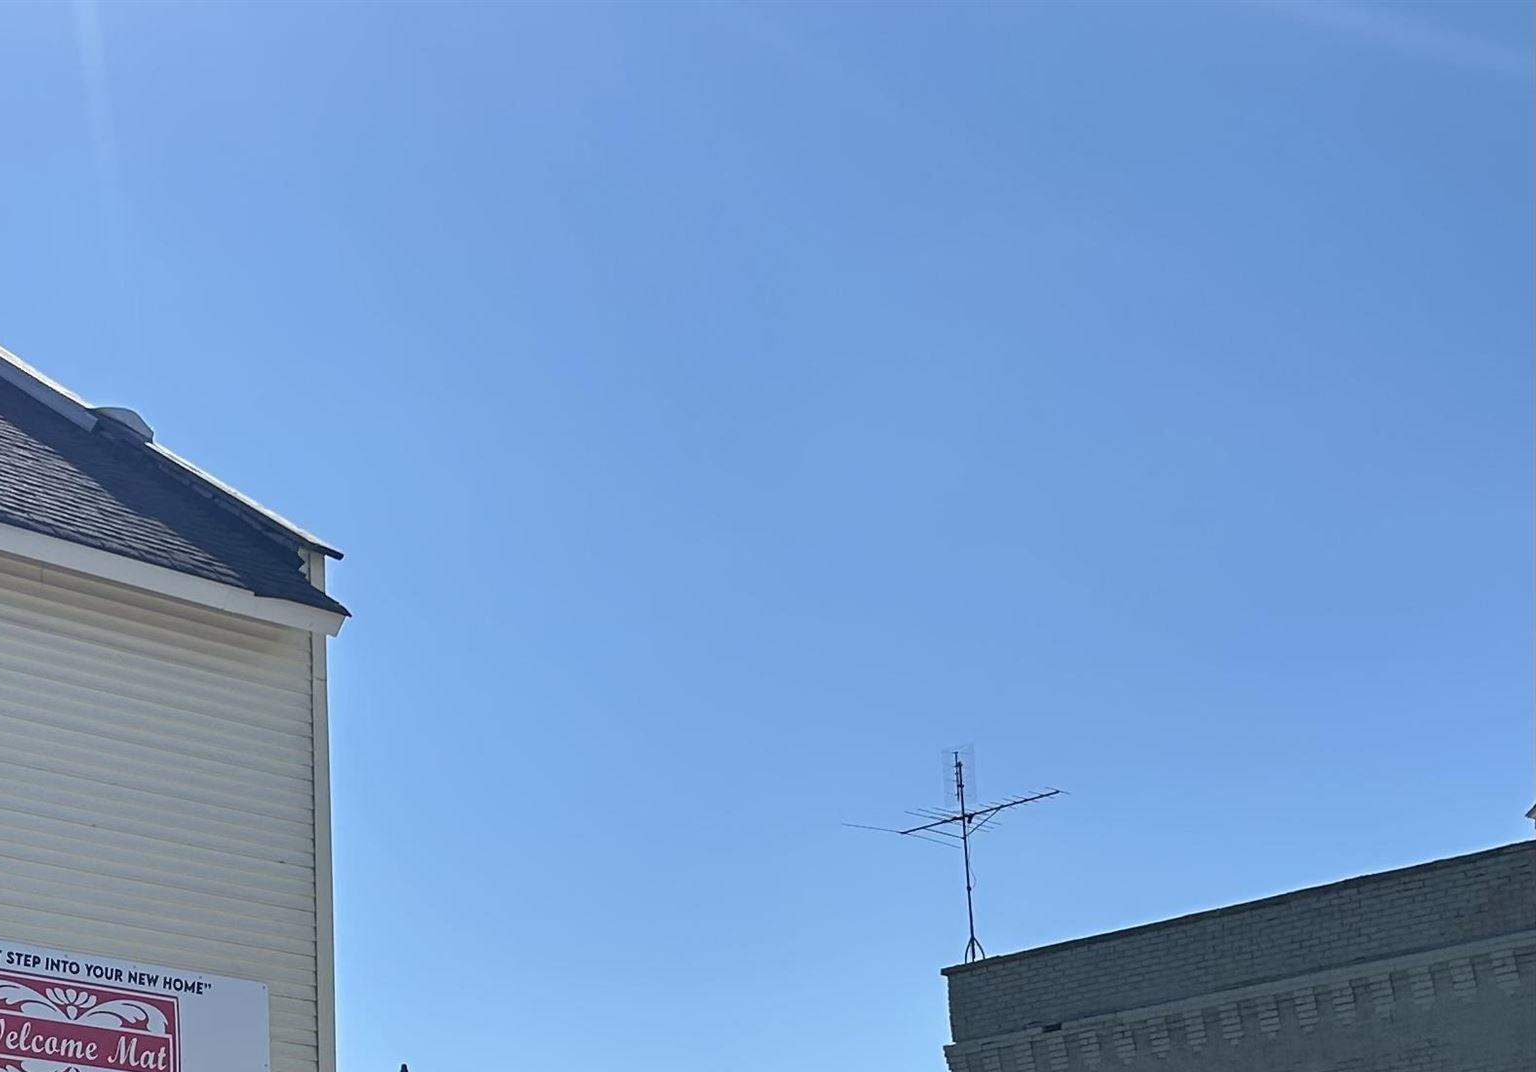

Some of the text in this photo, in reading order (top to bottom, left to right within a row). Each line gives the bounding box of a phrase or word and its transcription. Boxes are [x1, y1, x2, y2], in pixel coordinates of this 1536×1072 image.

[6, 950, 41, 968] STEP
[45, 957, 80, 975] INTO
[84, 963, 123, 983] YOUR
[127, 970, 159, 987] NEW
[107, 1035, 168, 1071] Mat
